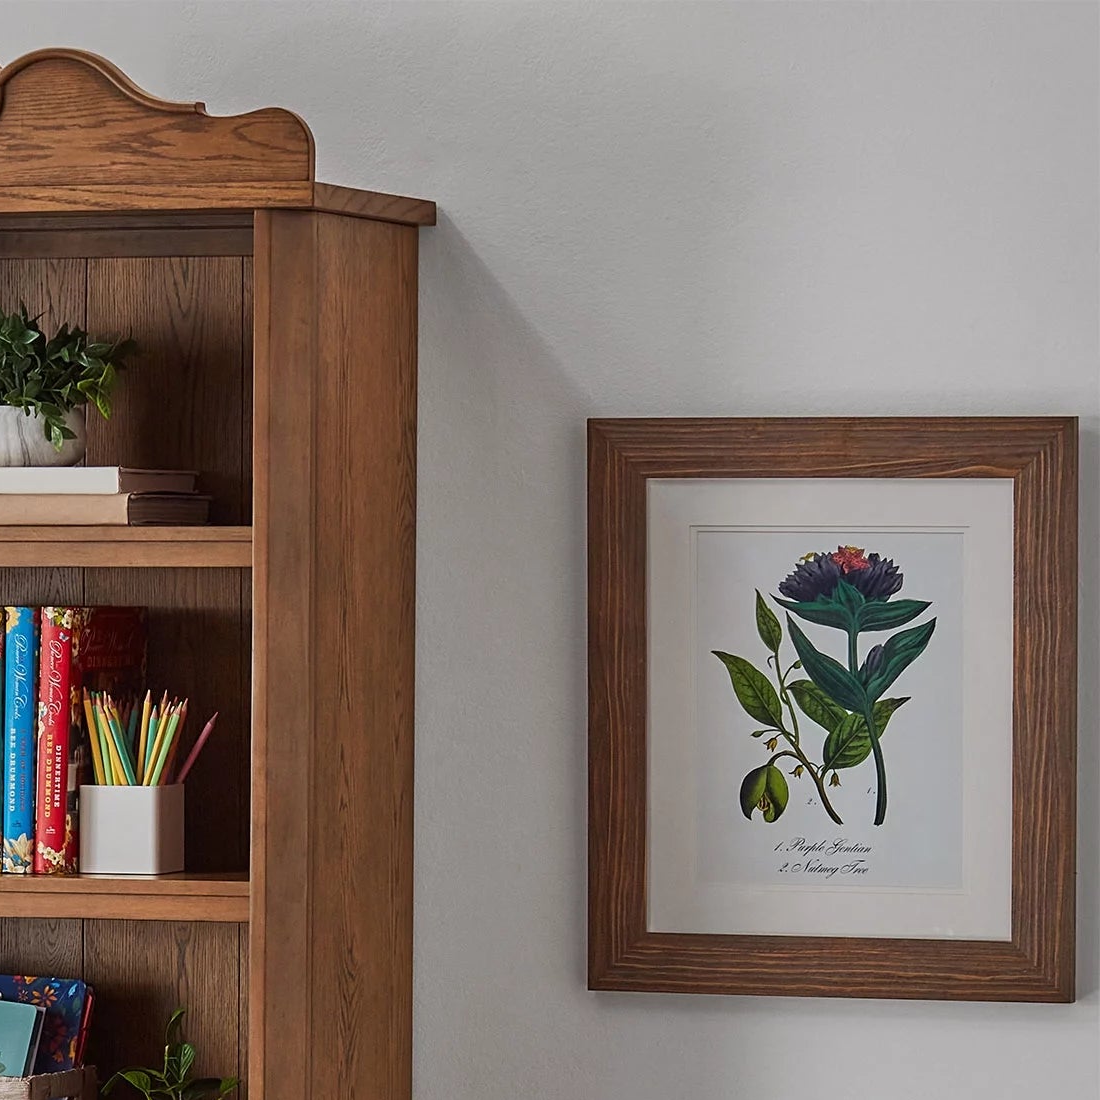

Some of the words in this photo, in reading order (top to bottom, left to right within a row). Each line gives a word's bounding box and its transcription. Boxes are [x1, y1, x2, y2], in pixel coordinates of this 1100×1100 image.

[14, 634, 29, 664] Pioneer
[49, 639, 63, 670] Pioneer
[14, 664, 29, 697] Woman
[48, 670, 63, 703] Woman
[47, 700, 62, 726] Cooks
[44, 758, 52, 818] DRUMMOND
[54, 744, 62, 808] DINNERTIME
[774, 841, 783, 852] 1.
[786, 837, 826, 856] Purple
[825, 838, 872, 856] Gentian
[778, 862, 788, 873] 2.
[791, 858, 839, 880] Nutmeg
[840, 860, 869, 874] Tree
